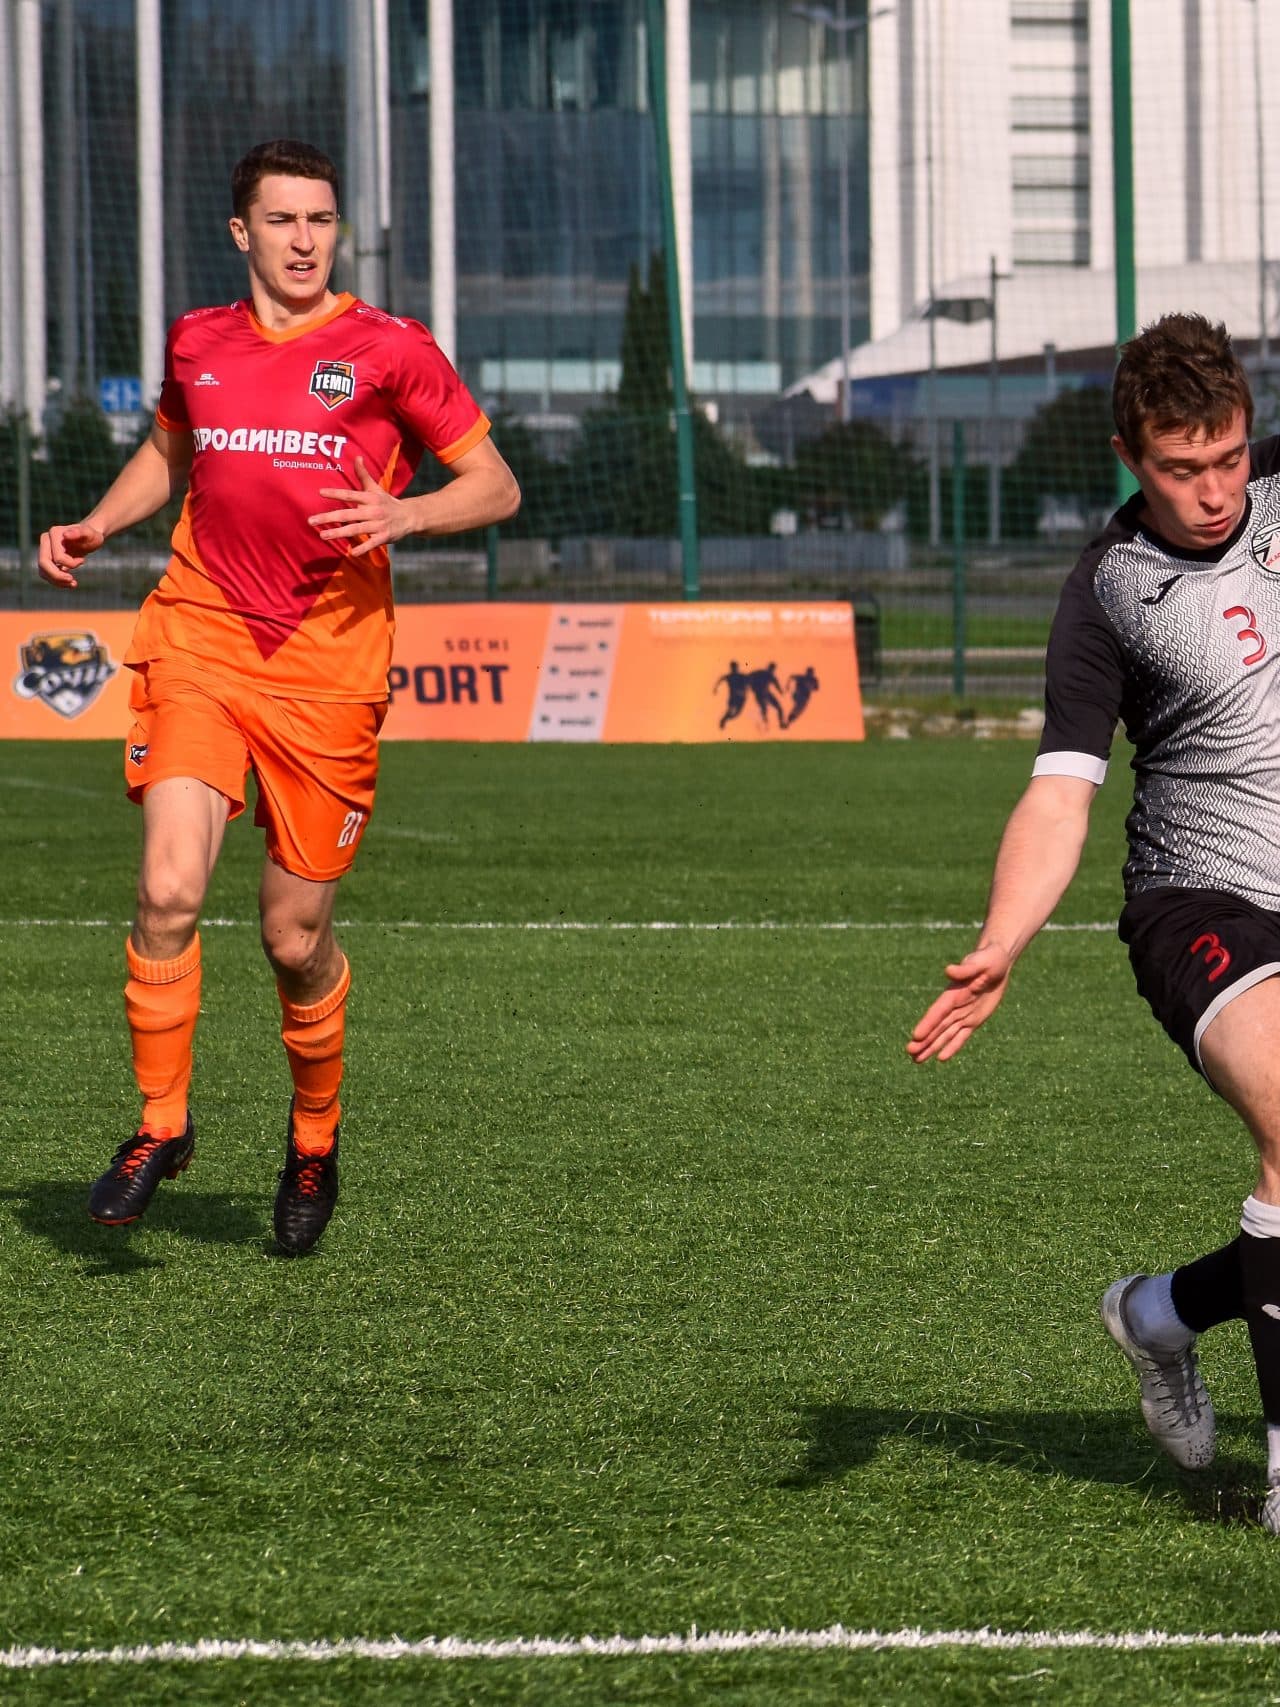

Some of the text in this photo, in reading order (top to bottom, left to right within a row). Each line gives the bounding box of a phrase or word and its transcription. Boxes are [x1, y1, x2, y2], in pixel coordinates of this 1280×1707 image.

[315, 373, 351, 395] ТЕМП
[192, 427, 347, 459] ПРОДИНВЕСТ
[273, 458, 324, 470] Бродников
[445, 637, 509, 652] SOCHI
[1223, 605, 1267, 666] 3
[387, 664, 510, 705] PORT
[1190, 933, 1231, 983] 3
